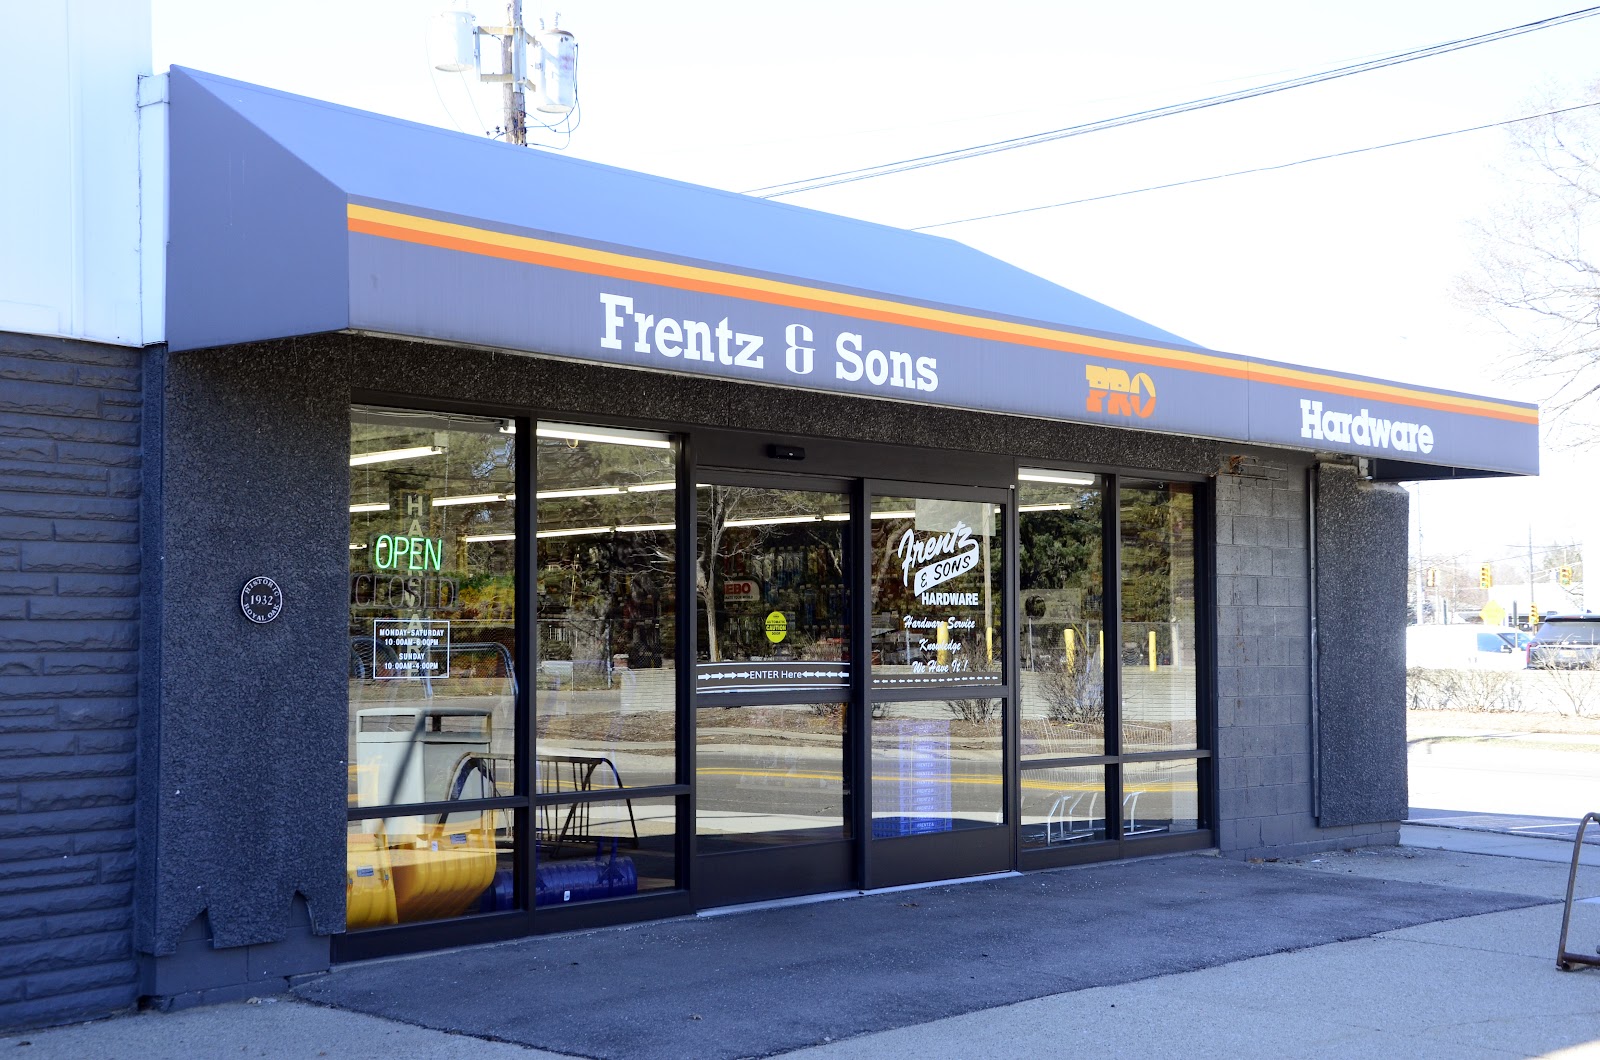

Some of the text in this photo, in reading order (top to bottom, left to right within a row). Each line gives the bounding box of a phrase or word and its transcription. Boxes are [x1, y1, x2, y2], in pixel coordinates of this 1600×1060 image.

[600, 293, 939, 393] Frentz & Sons
[1085, 364, 1157, 419] PRO
[1300, 398, 1435, 454] Hardware
[375, 534, 443, 571] OPEN
[898, 521, 979, 587] Frentz
[933, 555, 972, 581] SONS
[244, 579, 279, 596] HISTORIC
[355, 574, 455, 609] CLOSED
[250, 594, 274, 606] 1932
[921, 592, 979, 606] HARDWARE
[244, 603, 280, 620] ROYAL OAK
[903, 614, 976, 630] Hardware Service
[918, 638, 962, 655] Knowledge
[398, 652, 426, 661] SUNDAY
[750, 670, 802, 680] ENTER Here
[911, 660, 926, 674] We
[927, 659, 950, 673] Have
